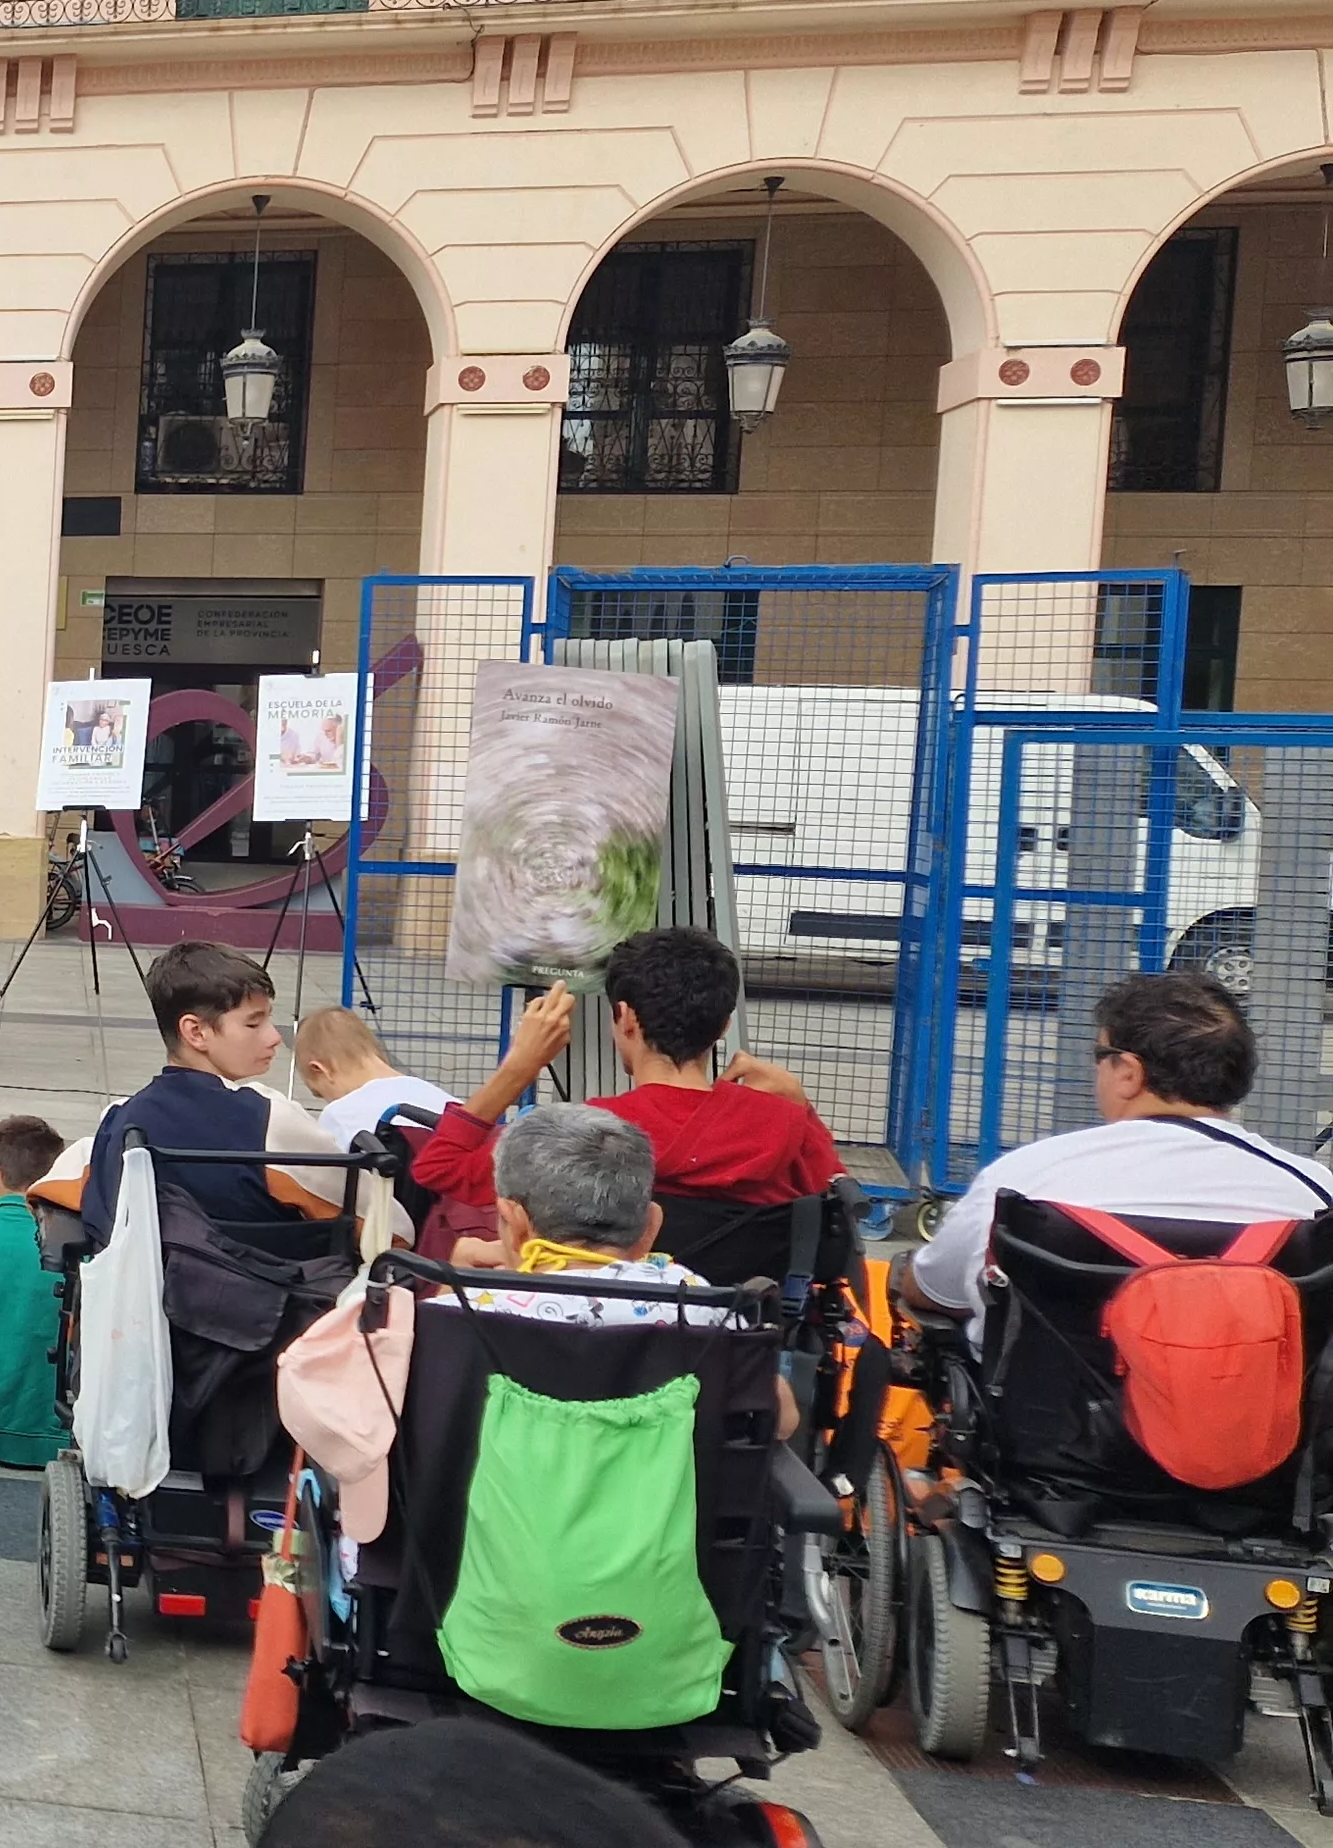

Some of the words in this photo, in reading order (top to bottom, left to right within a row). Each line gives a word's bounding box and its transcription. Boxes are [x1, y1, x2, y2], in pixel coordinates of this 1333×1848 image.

[103, 628, 171, 641] EPYME
[107, 644, 170, 655] UESCA
[268, 700, 313, 709] ESCUELA
[315, 700, 328, 708] DE
[502, 688, 551, 704] Avanza
[556, 693, 567, 705] el
[571, 695, 613, 709] olvido
[268, 708, 334, 719] MEMORIA
[500, 710, 530, 722] Javier
[533, 713, 572, 726] Ramón
[574, 717, 602, 729] Jarne
[52, 753, 112, 763] FAMILIAR
[532, 965, 585, 978] PREGUNTA
